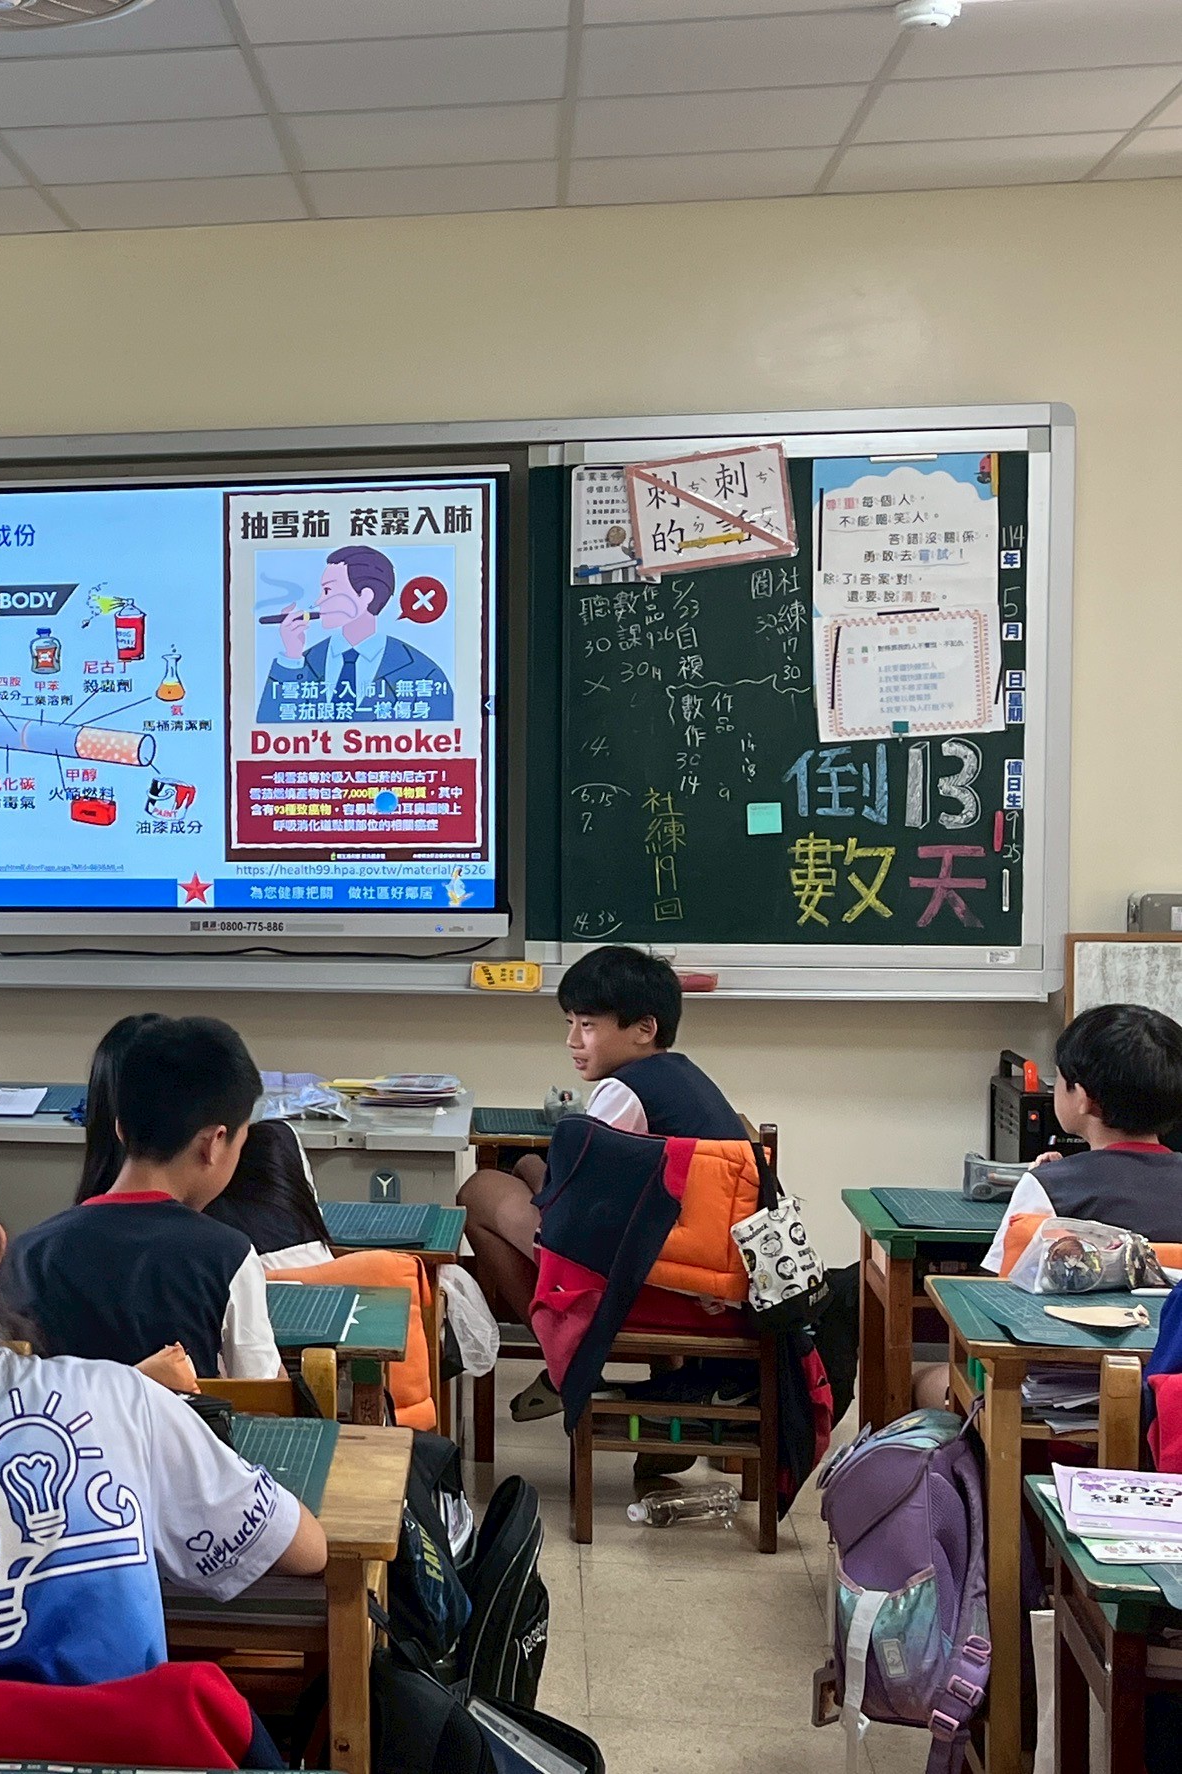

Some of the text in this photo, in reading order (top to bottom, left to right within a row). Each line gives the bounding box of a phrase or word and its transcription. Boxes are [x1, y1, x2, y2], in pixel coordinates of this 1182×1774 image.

[241, 505, 472, 539] 抽雪茄 菸霧入肺
[1003, 552, 1019, 566] 年
[1003, 586, 1021, 618] 5
[1005, 624, 1020, 638] 月
[83, 660, 131, 675] 尼古丁
[34, 680, 60, 692] 甲苯
[83, 678, 133, 694] 殺蟲劑
[1009, 673, 1023, 687] 日
[21, 695, 73, 706] 工業溶劑
[279, 702, 431, 721] 雪茄跟菸一樣傷身
[143, 720, 212, 732] 馬桶清潔劑
[343, 728, 461, 753] Smoke!
[66, 768, 97, 782] 甲醇
[782, 737, 983, 830] 倒 13
[1006, 761, 1023, 808] 值日生
[136, 820, 203, 834] 油漆成分
[787, 832, 987, 928] 數 天
[250, 885, 434, 900] 為您健康把關 做社區好鄰居
[220, 921, 284, 932] 0800-775-886
